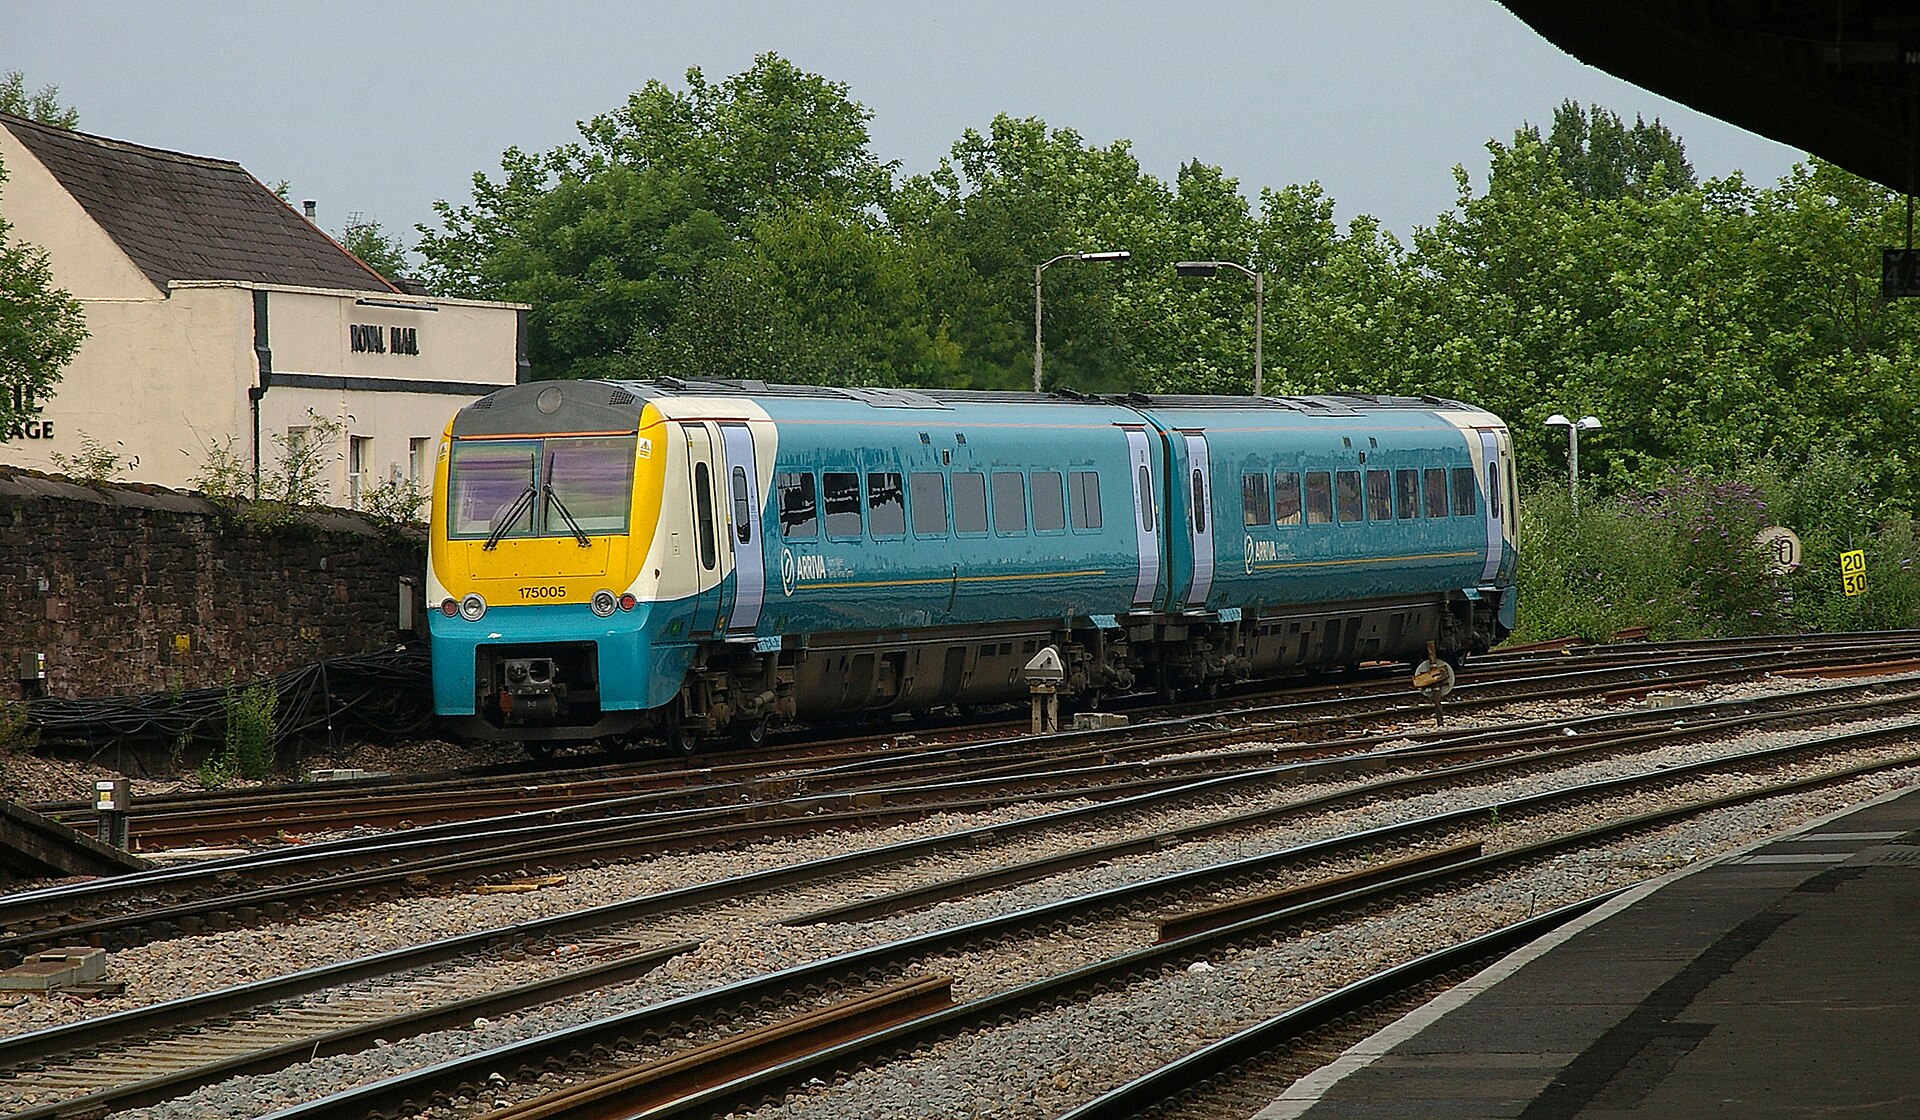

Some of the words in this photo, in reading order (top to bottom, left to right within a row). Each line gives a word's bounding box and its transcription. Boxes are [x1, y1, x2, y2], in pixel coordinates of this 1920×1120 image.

[350, 324, 386, 354] ROYAL
[390, 327, 420, 356] MAIL
[9, 421, 54, 439] AGE
[1255, 541, 1277, 562] ARRIVA
[796, 555, 826, 580] ARRIVA
[1843, 553, 1863, 572] 20
[518, 586, 566, 599] 175005
[1845, 574, 1866, 594] 30
